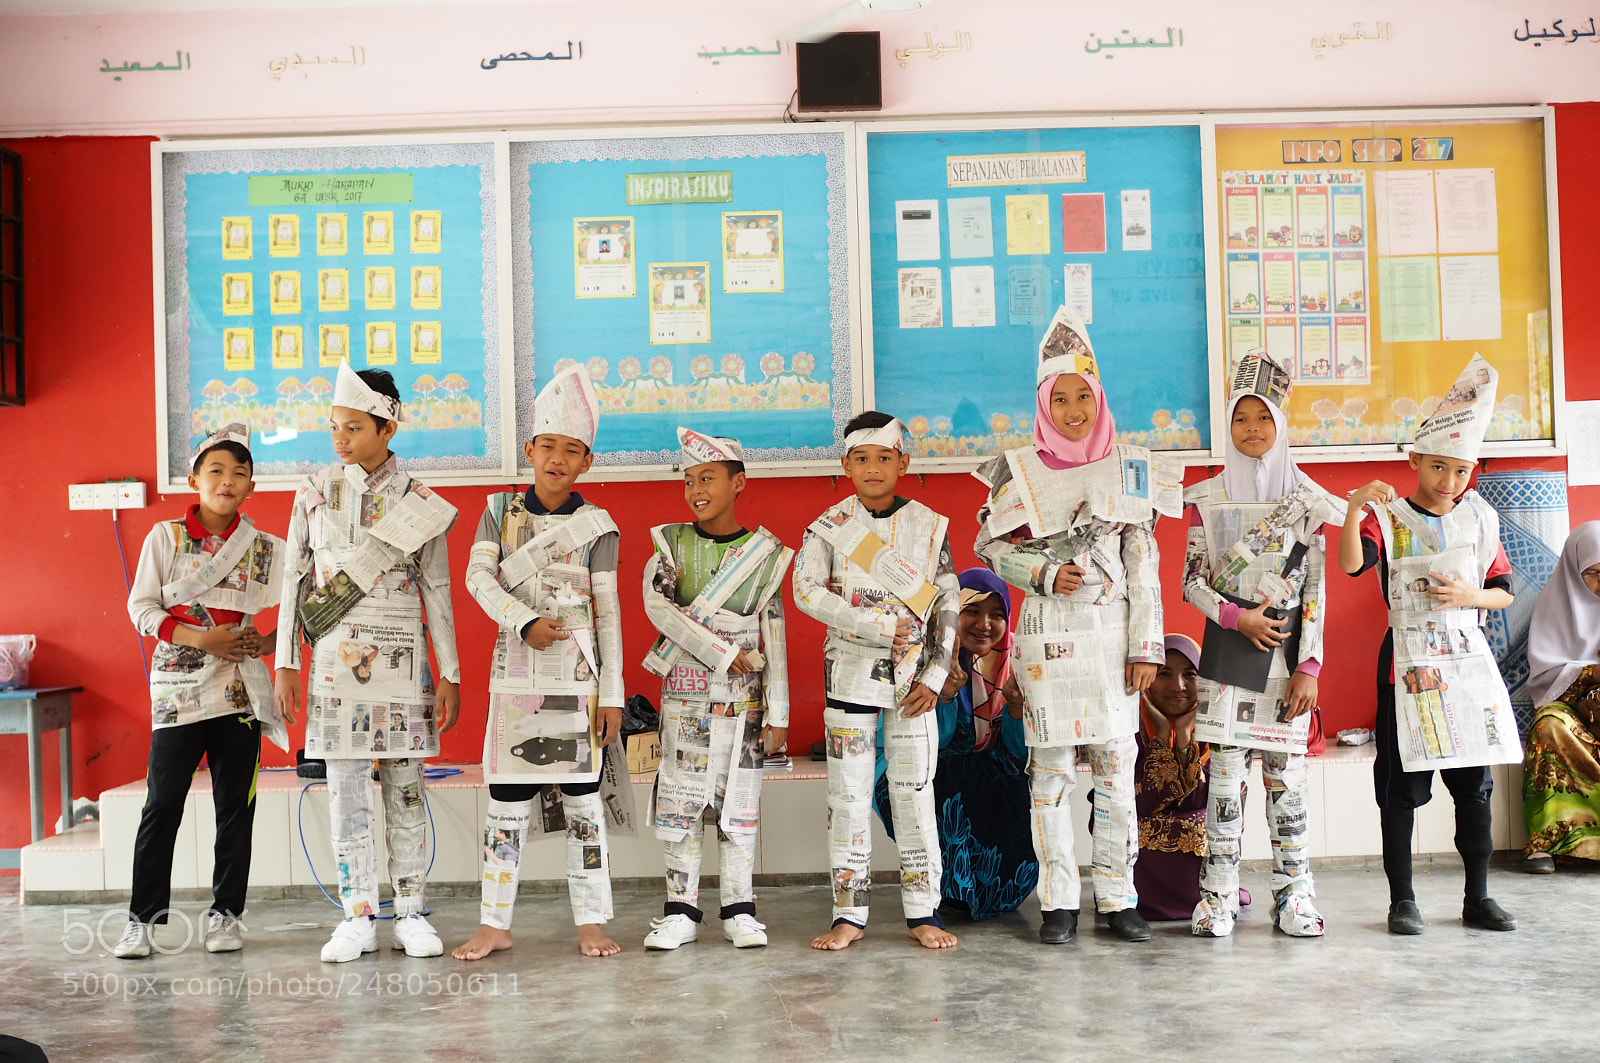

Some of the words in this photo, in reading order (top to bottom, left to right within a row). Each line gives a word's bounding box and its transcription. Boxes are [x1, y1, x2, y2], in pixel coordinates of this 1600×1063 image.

[1283, 140, 1341, 163] INFO
[1353, 139, 1402, 162] SKP
[953, 160, 1015, 181] SEPANJANG
[1020, 156, 1079, 178] PERJALANAN
[629, 174, 730, 200] INSPIRASIKU
[1238, 174, 1288, 185] SELAMAT
[1294, 173, 1322, 184] HARI
[1327, 173, 1353, 184] JADI
[344, 191, 363, 203] 2017
[1242, 361, 1259, 389] UNTUK
[854, 587, 890, 599] HIKMAH
[1208, 720, 1225, 729] Warga
